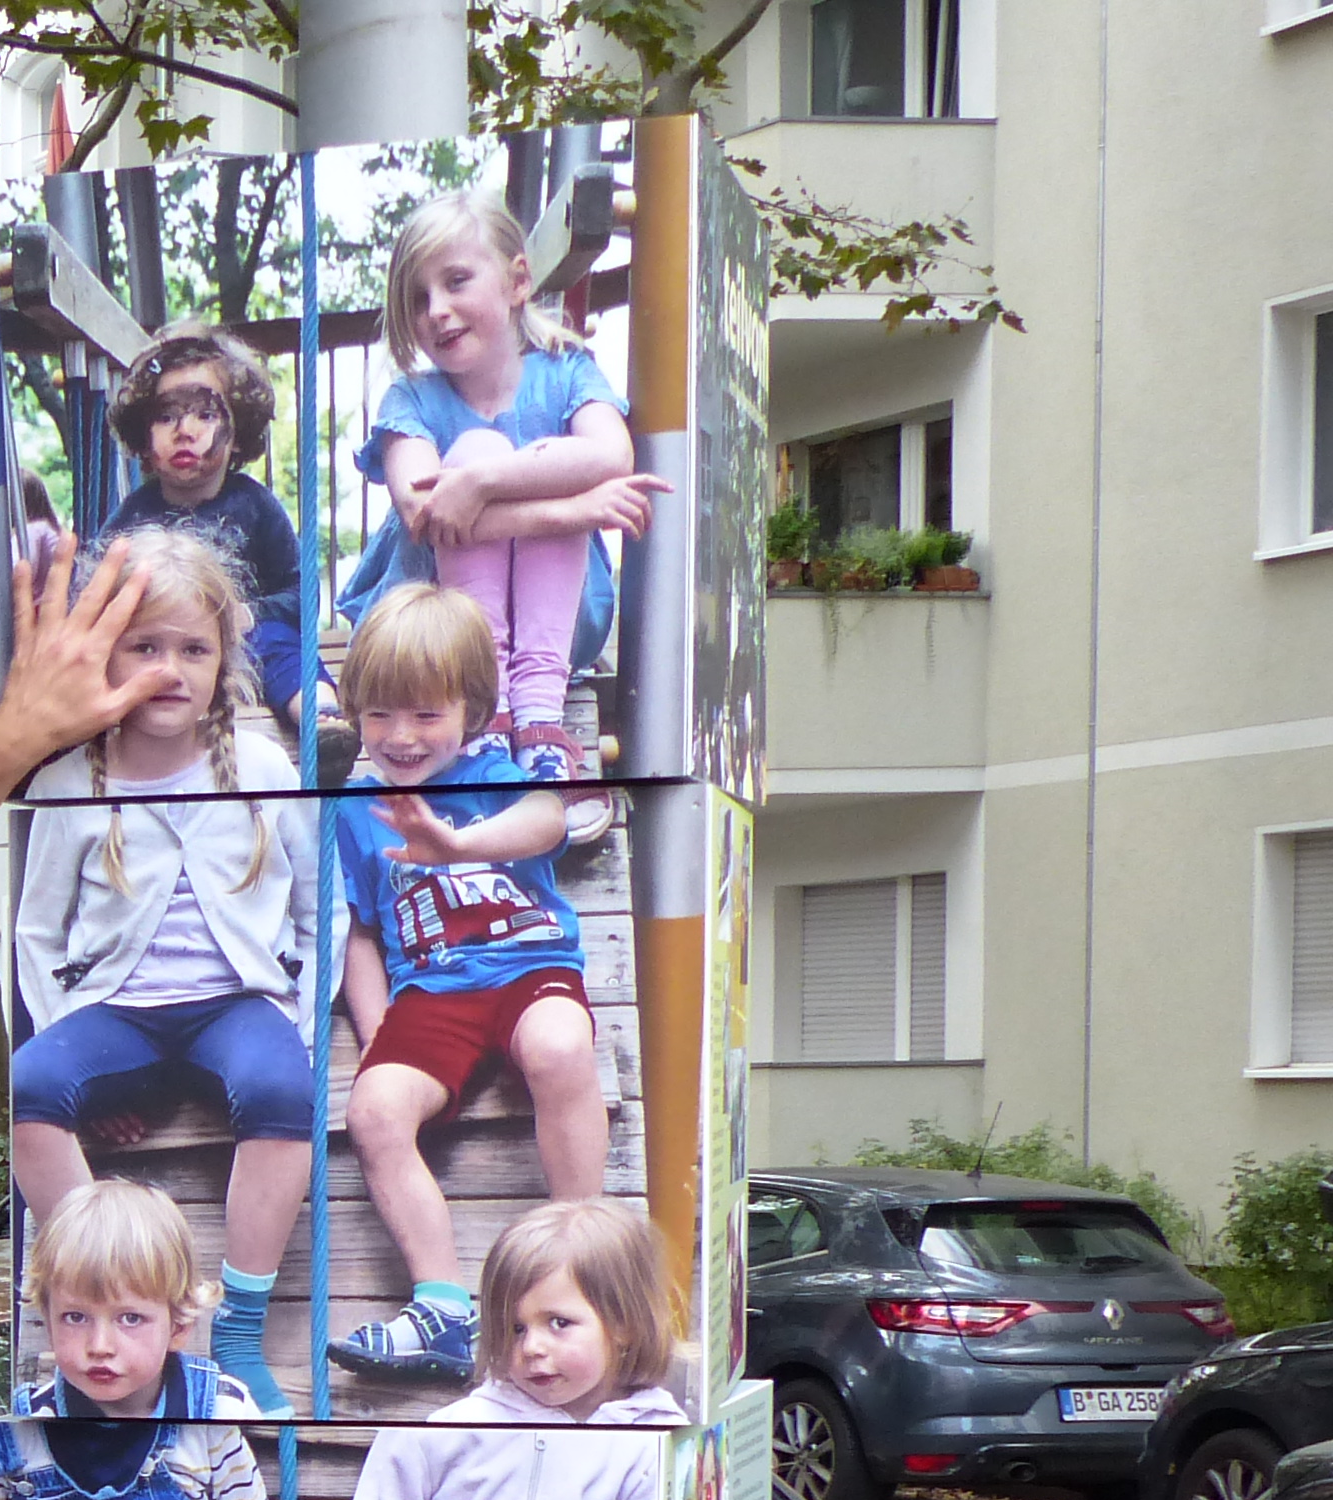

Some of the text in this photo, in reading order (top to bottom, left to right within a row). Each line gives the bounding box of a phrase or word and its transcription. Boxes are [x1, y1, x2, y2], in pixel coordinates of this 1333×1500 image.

[1073, 1391, 1162, 1412] B GA 258
